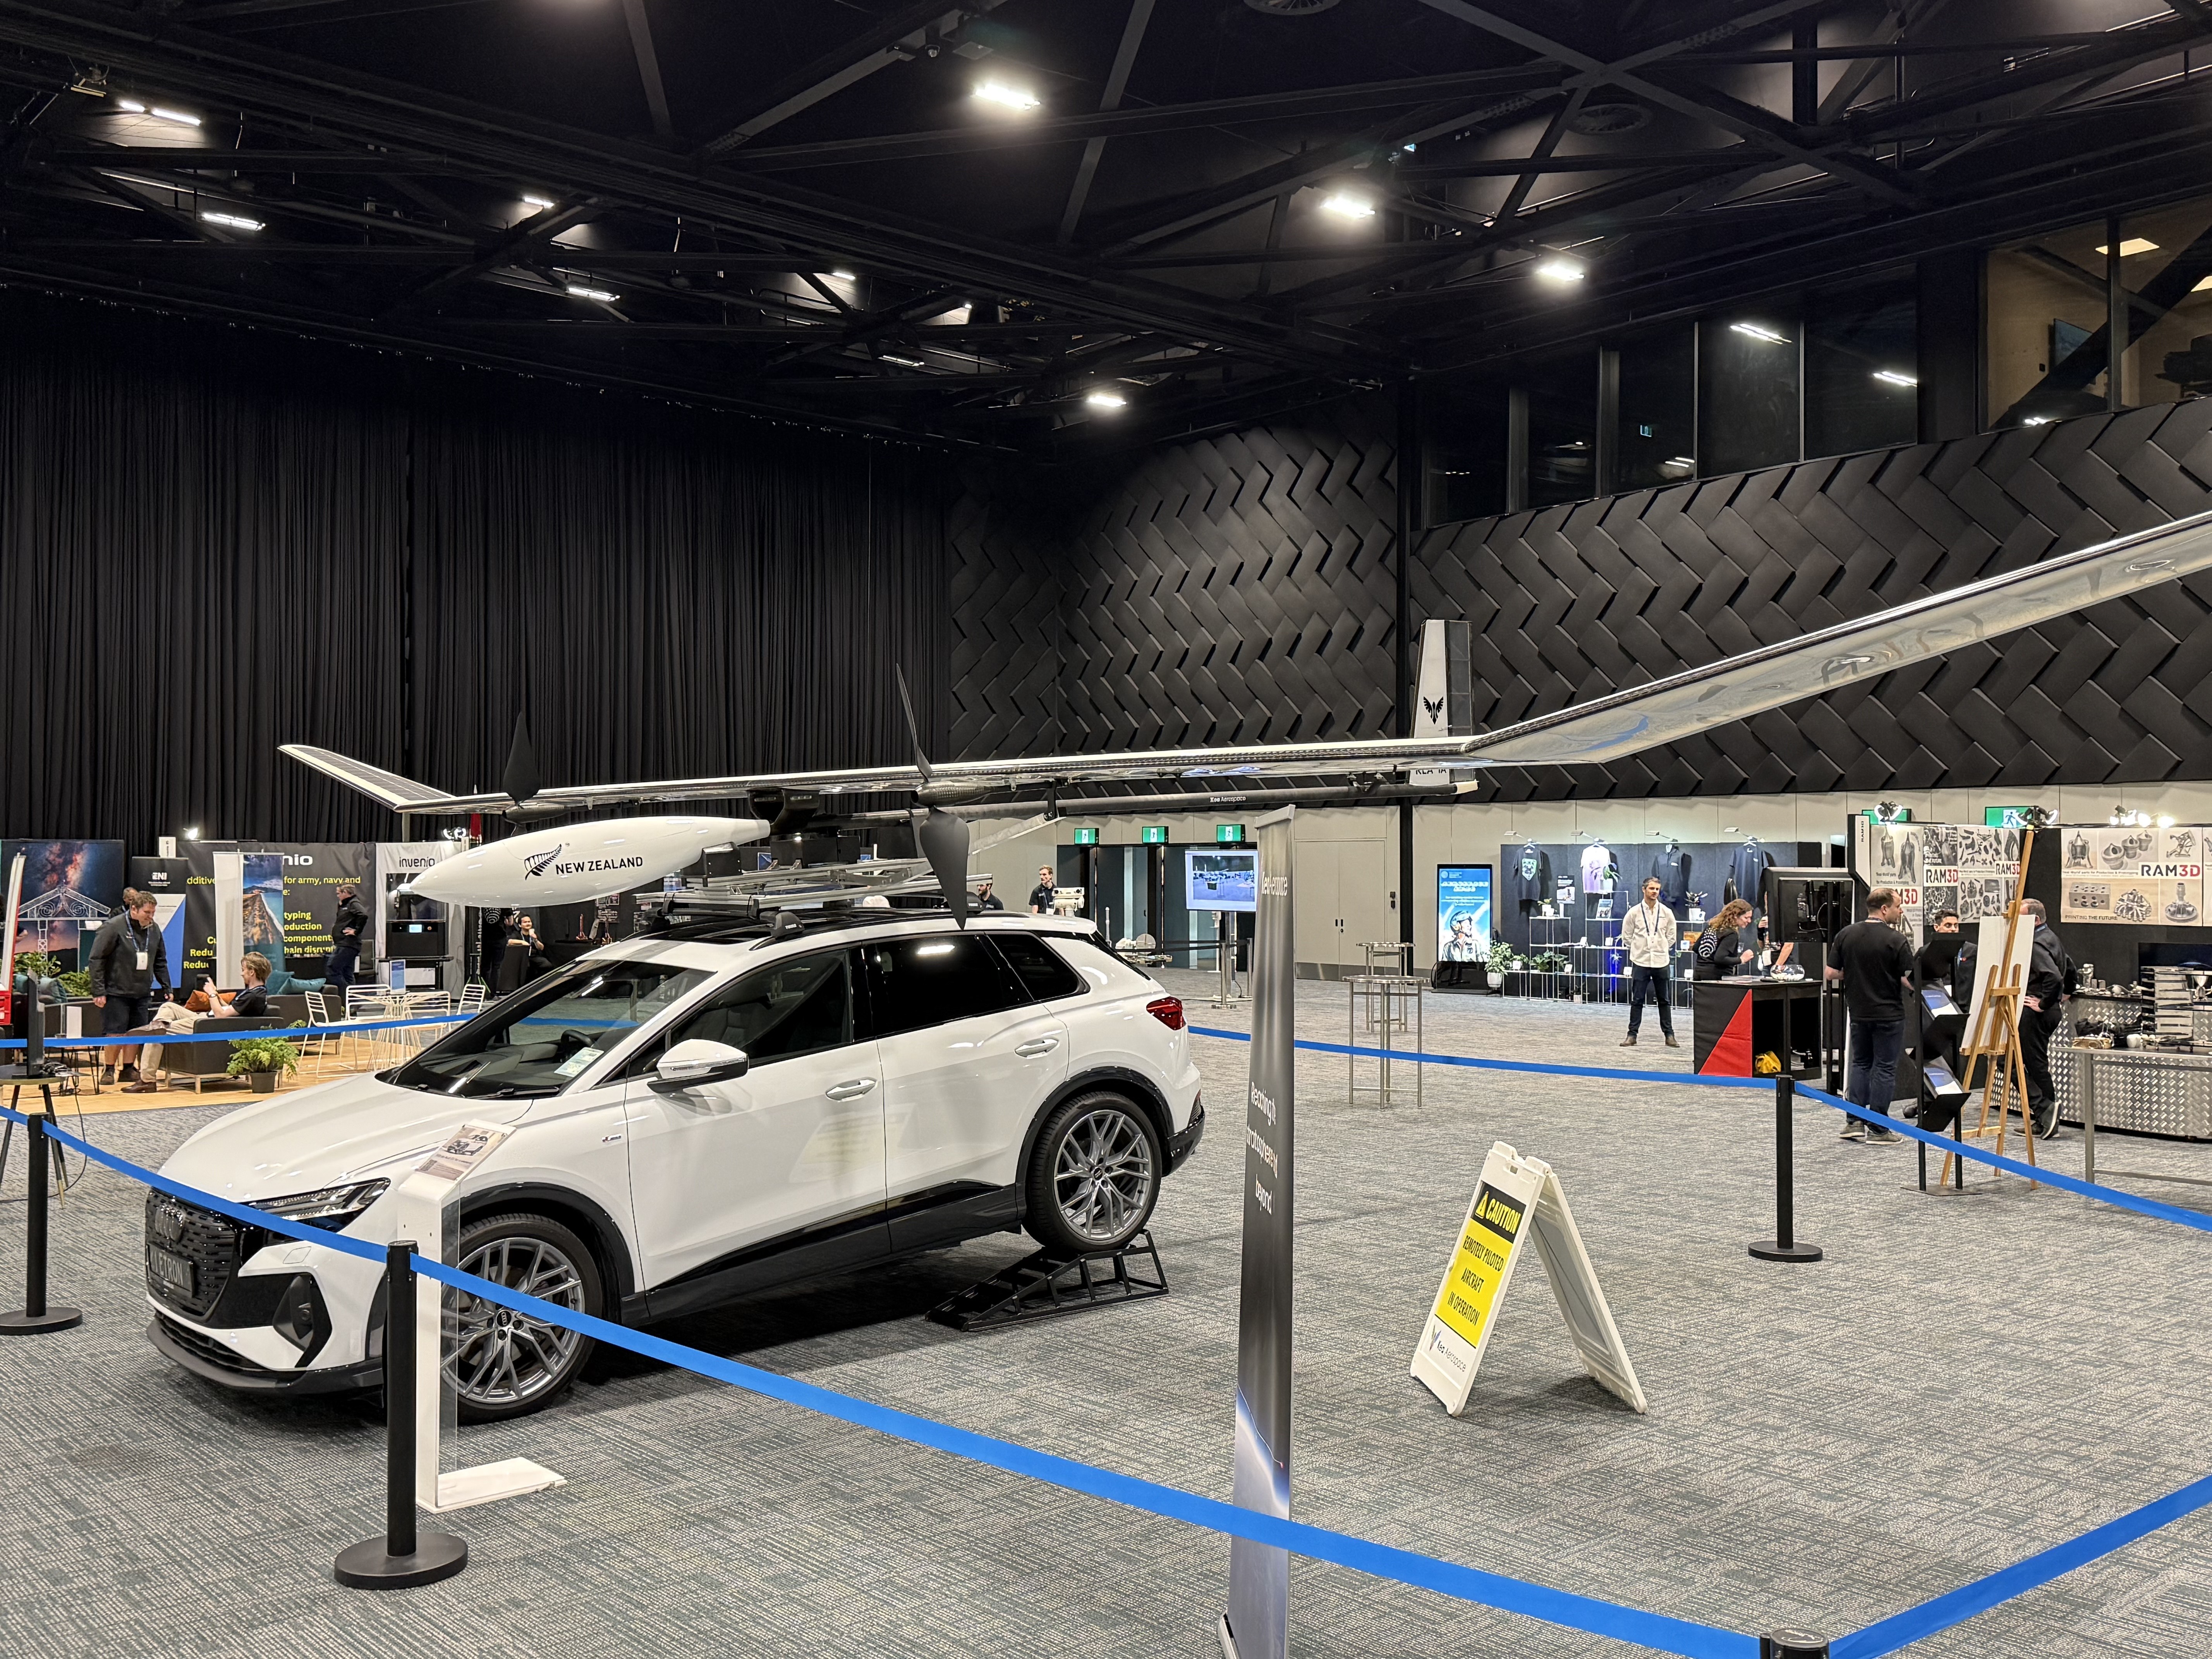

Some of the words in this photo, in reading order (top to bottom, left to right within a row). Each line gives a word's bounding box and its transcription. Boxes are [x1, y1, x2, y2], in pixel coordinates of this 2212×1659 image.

[399, 856, 435, 867] invenio
[555, 862, 585, 874] NEW
[587, 857, 643, 871] ZEALAND
[1925, 869, 1958, 883] RAM3D
[2141, 864, 2200, 877] RAM3D
[187, 876, 215, 884] dditive
[298, 878, 321, 886] army,
[284, 922, 322, 930] oduction
[1486, 1198, 1521, 1234] CAUTION
[1462, 1235, 1486, 1262] REMOTELY
[1482, 1248, 1504, 1272] PILOTED
[1460, 1267, 1484, 1293] AIRCRAFT
[1447, 1291, 1455, 1307] IN
[1453, 1295, 1480, 1326] OPERATION
[1444, 1348, 1466, 1372] Aerospace
